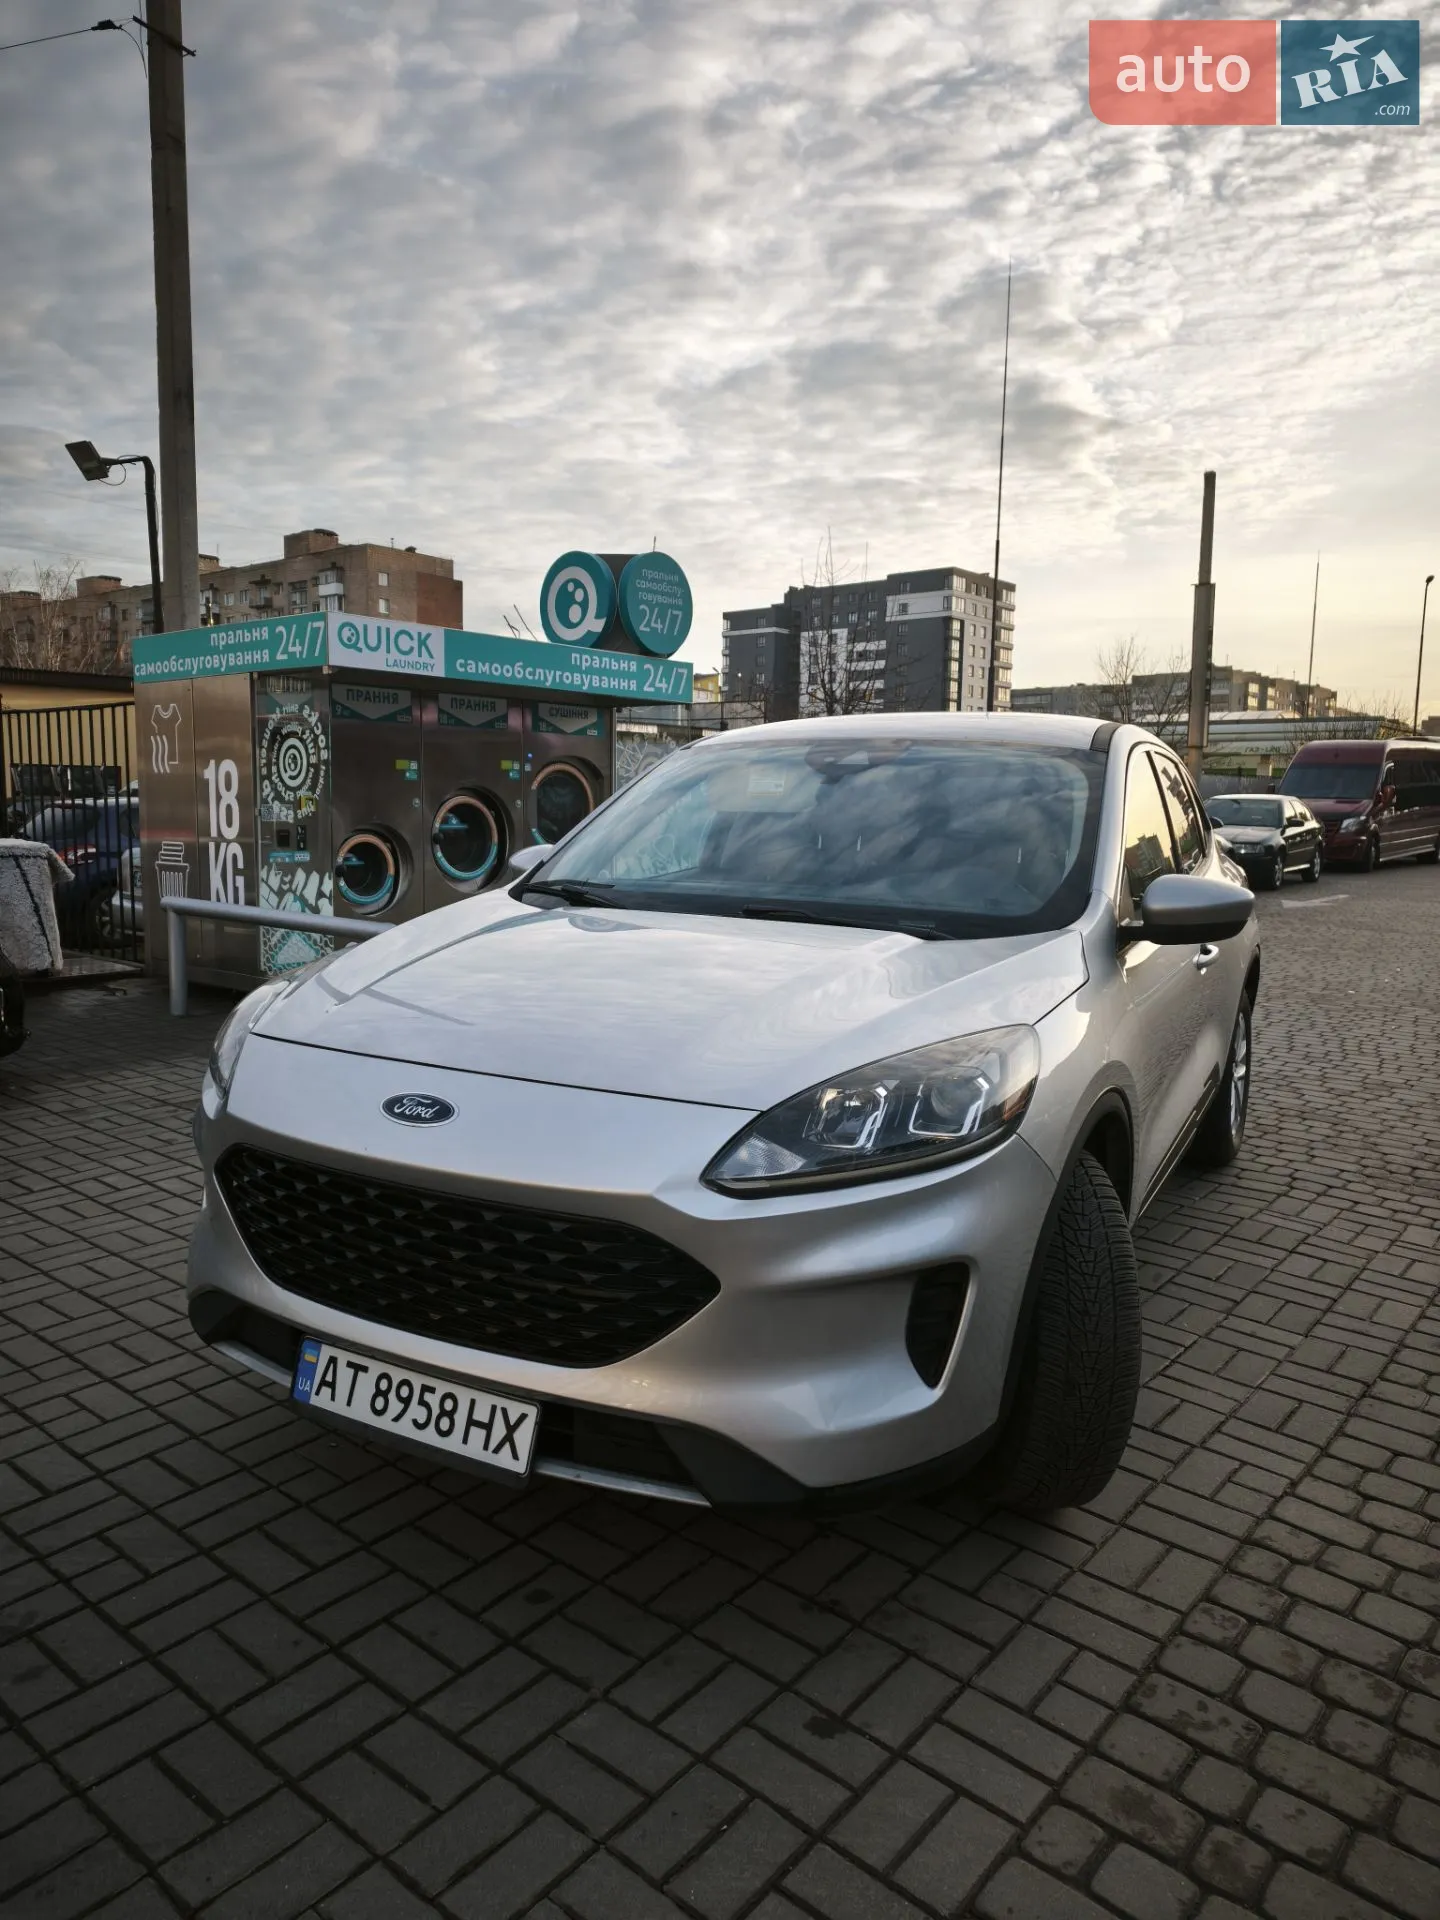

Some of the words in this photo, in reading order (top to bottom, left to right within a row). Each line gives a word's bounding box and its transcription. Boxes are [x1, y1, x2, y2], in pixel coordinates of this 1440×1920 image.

[642, 568, 679, 582] пральня
[639, 604, 683, 636] 24/7
[210, 625, 269, 648] пральня
[275, 620, 325, 661] 24/7
[337, 621, 434, 660] QUICK
[134, 648, 270, 676] самообслуговування
[385, 658, 435, 673] LAUNDRY
[455, 658, 637, 691] самообслуговування
[571, 651, 637, 673] пральня
[643, 663, 688, 695] 24/7
[346, 688, 399, 705] ПРАННЯ
[450, 697, 497, 713] ПРАННЯ
[203, 758, 240, 840] 18
[208, 841, 245, 906] KG
[394, 1096, 440, 1119] Ford
[298, 1376, 312, 1393] UA
[314, 1355, 370, 1407] AT
[369, 1372, 459, 1438] 8958
[461, 1398, 529, 1462] HX
